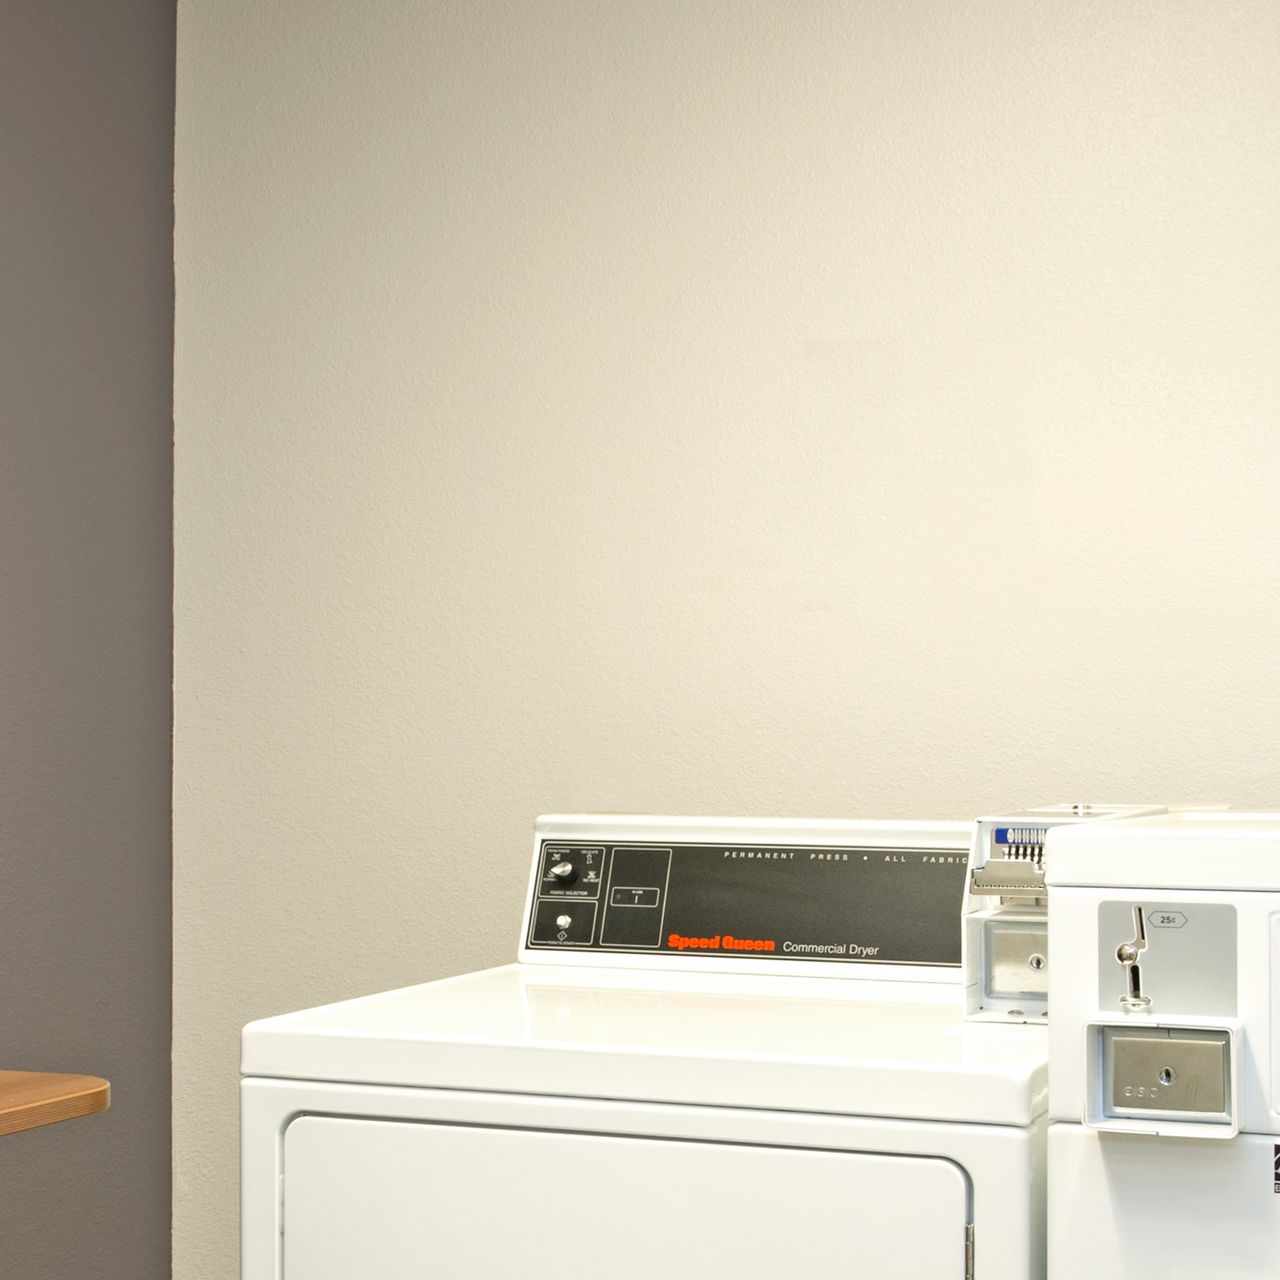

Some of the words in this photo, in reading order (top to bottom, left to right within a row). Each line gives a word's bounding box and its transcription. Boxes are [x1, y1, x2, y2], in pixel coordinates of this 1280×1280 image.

[724, 851, 795, 860] PERMANENT
[668, 934, 720, 950] Speed
[722, 936, 775, 951] Queen
[783, 941, 846, 953] Commercial
[850, 945, 879, 957] Dryer
